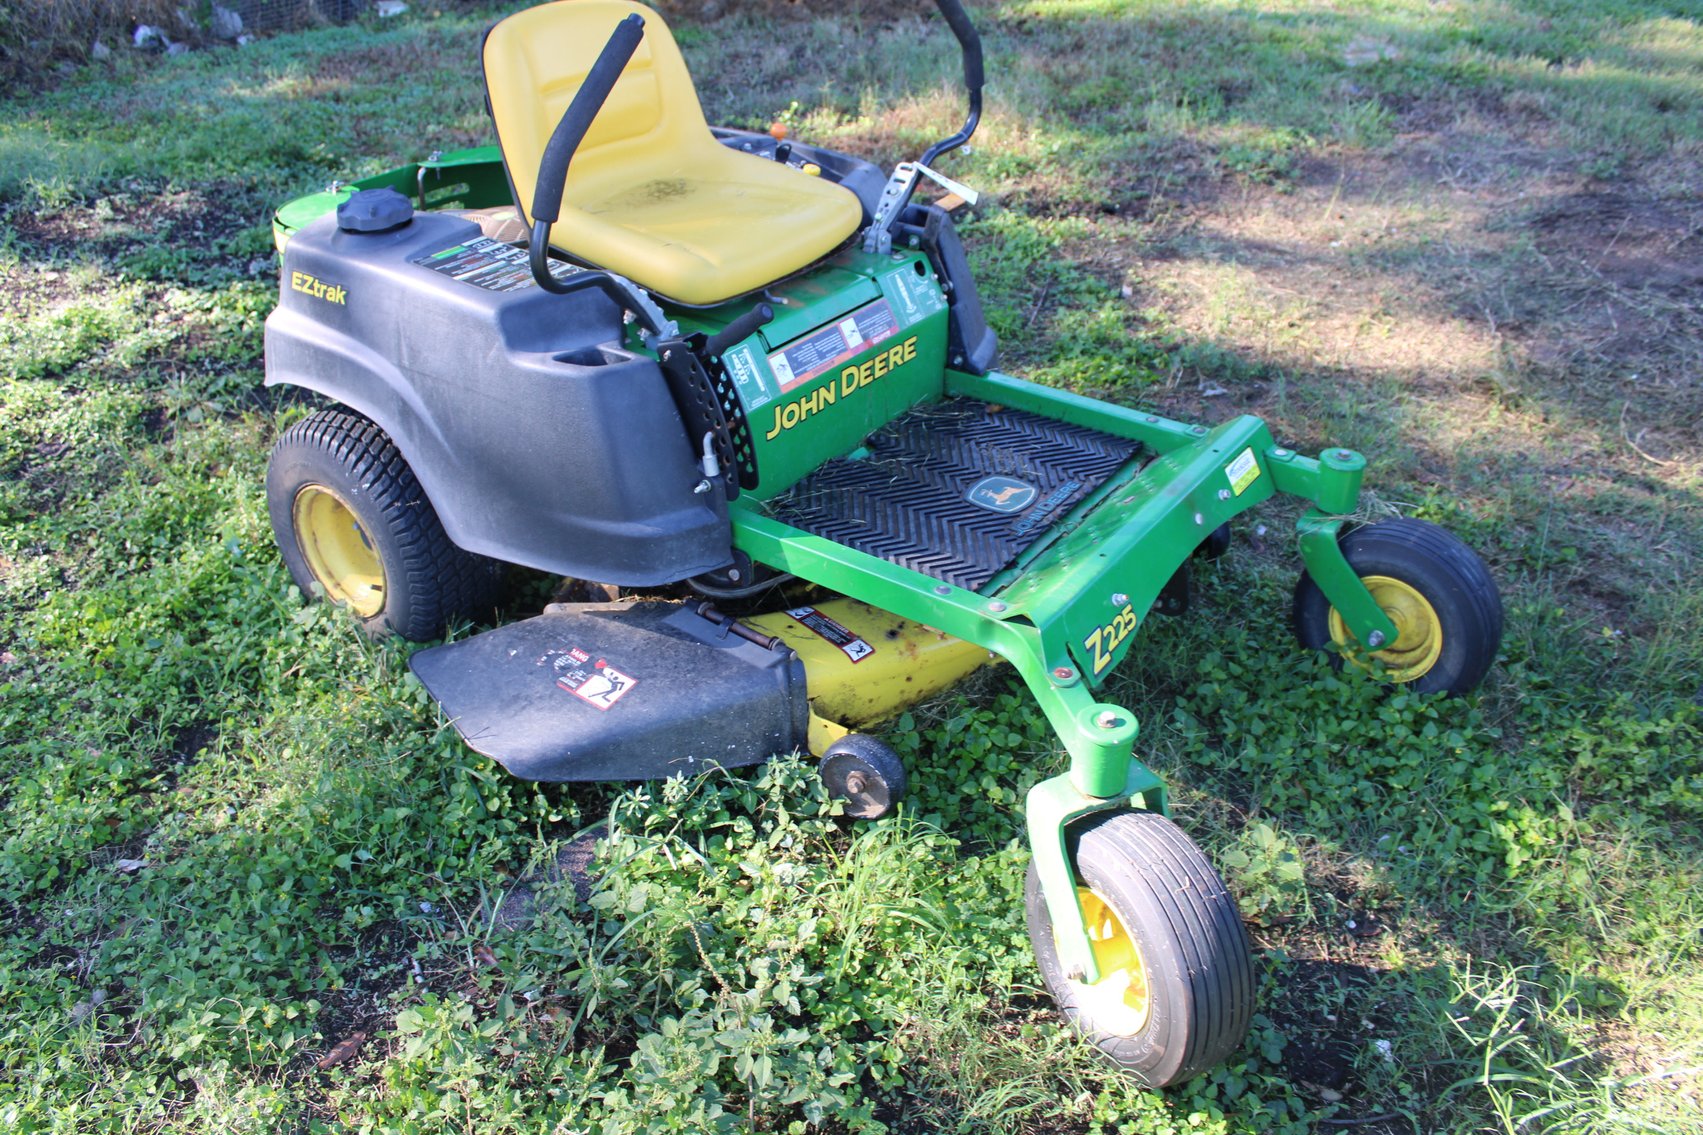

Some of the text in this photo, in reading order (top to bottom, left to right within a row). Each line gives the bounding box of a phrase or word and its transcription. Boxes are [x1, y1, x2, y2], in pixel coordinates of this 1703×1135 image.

[291, 271, 347, 305] EZtrak
[766, 379, 836, 441] JOHN
[841, 336, 918, 399] DEERE
[1013, 480, 1082, 537] JOHN DEERE
[1084, 603, 1137, 675] Z225
